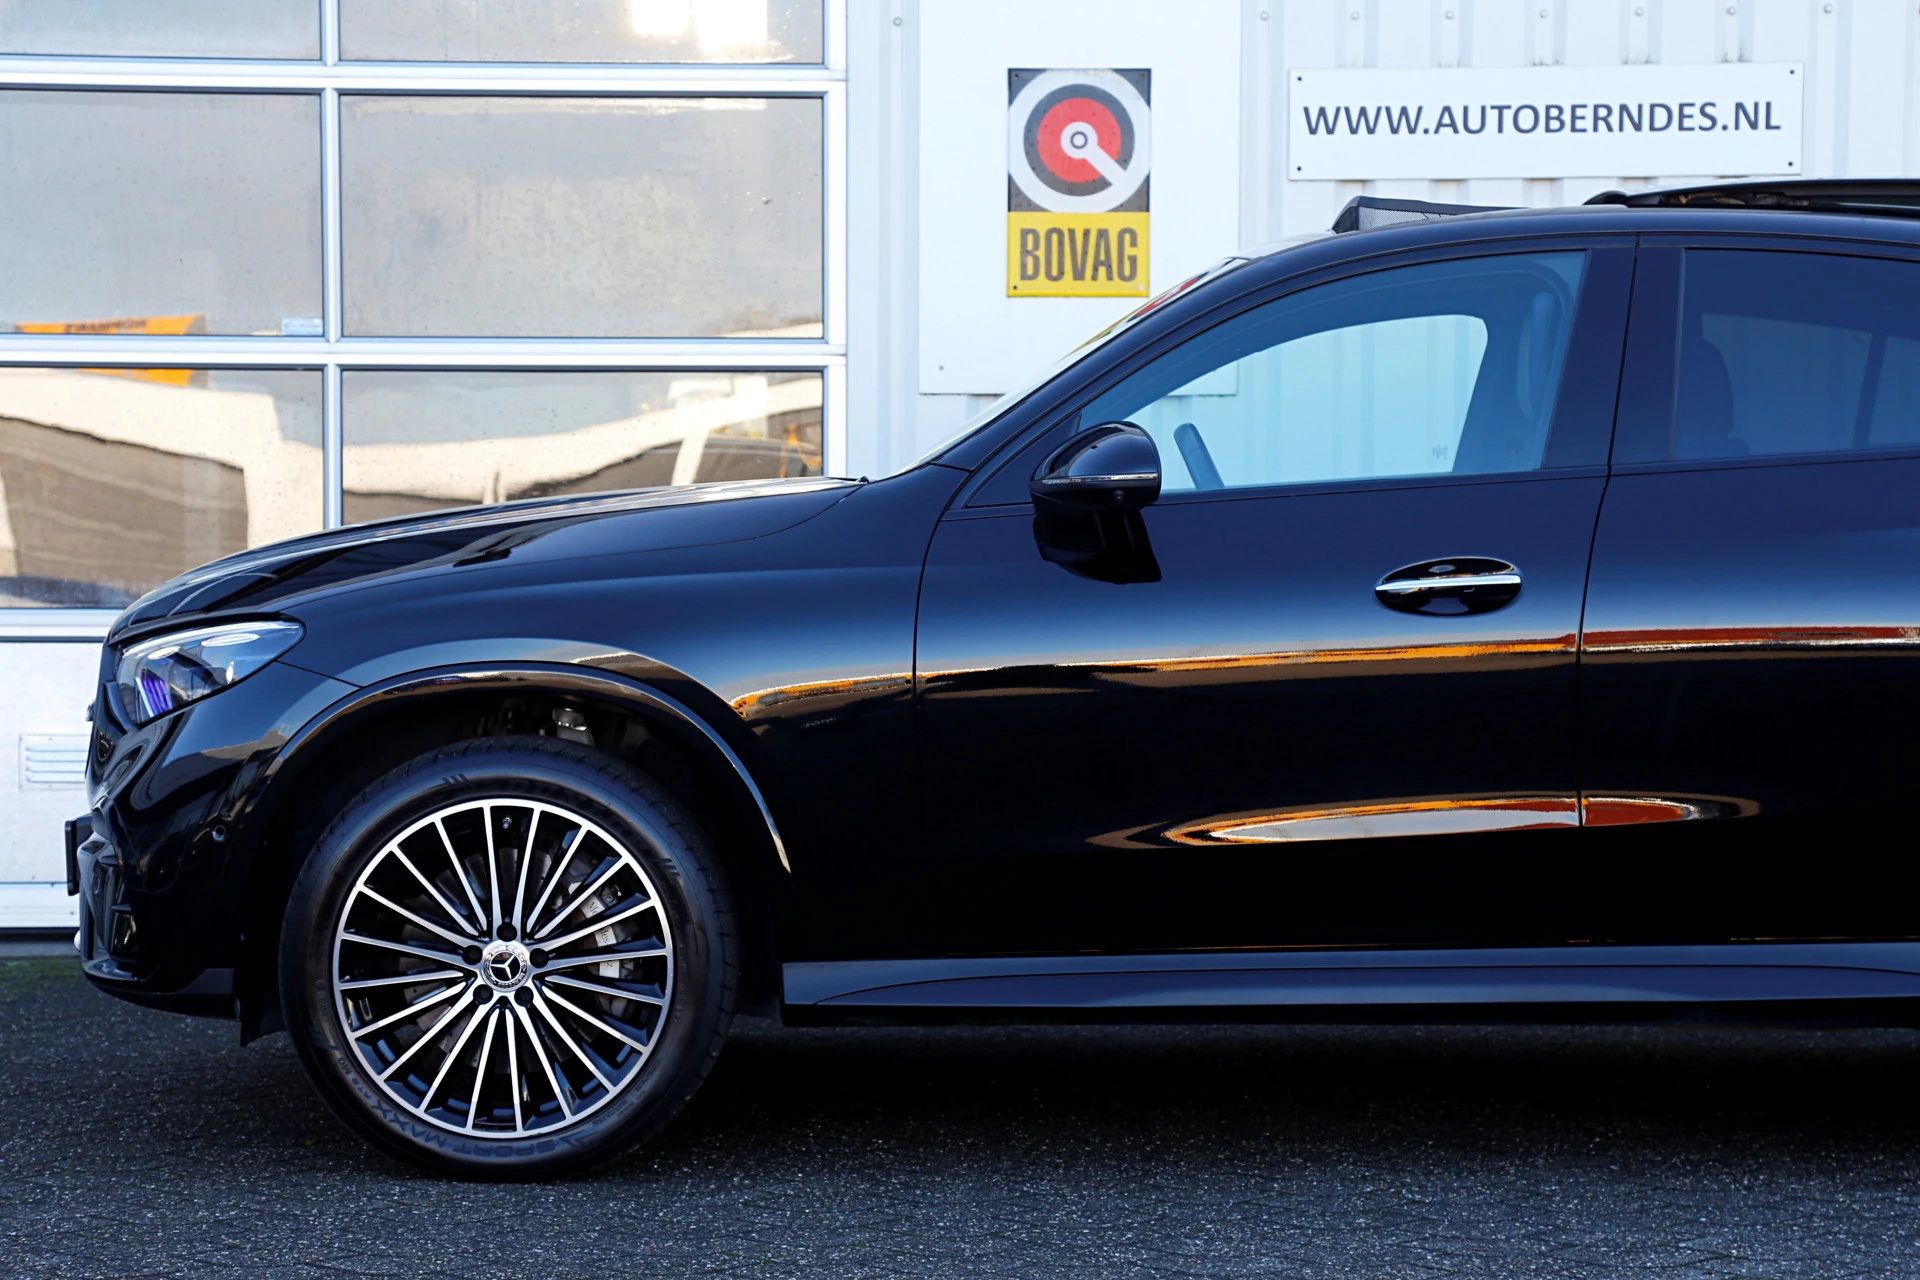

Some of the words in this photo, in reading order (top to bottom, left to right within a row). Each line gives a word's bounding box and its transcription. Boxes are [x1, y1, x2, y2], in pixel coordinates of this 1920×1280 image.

[1303, 100, 1782, 135] WWW.AUTOBERNDES.NL
[1019, 227, 1139, 282] BOVAG
[371, 1098, 447, 1150] MAXX
[452, 1139, 557, 1158] SPORT
